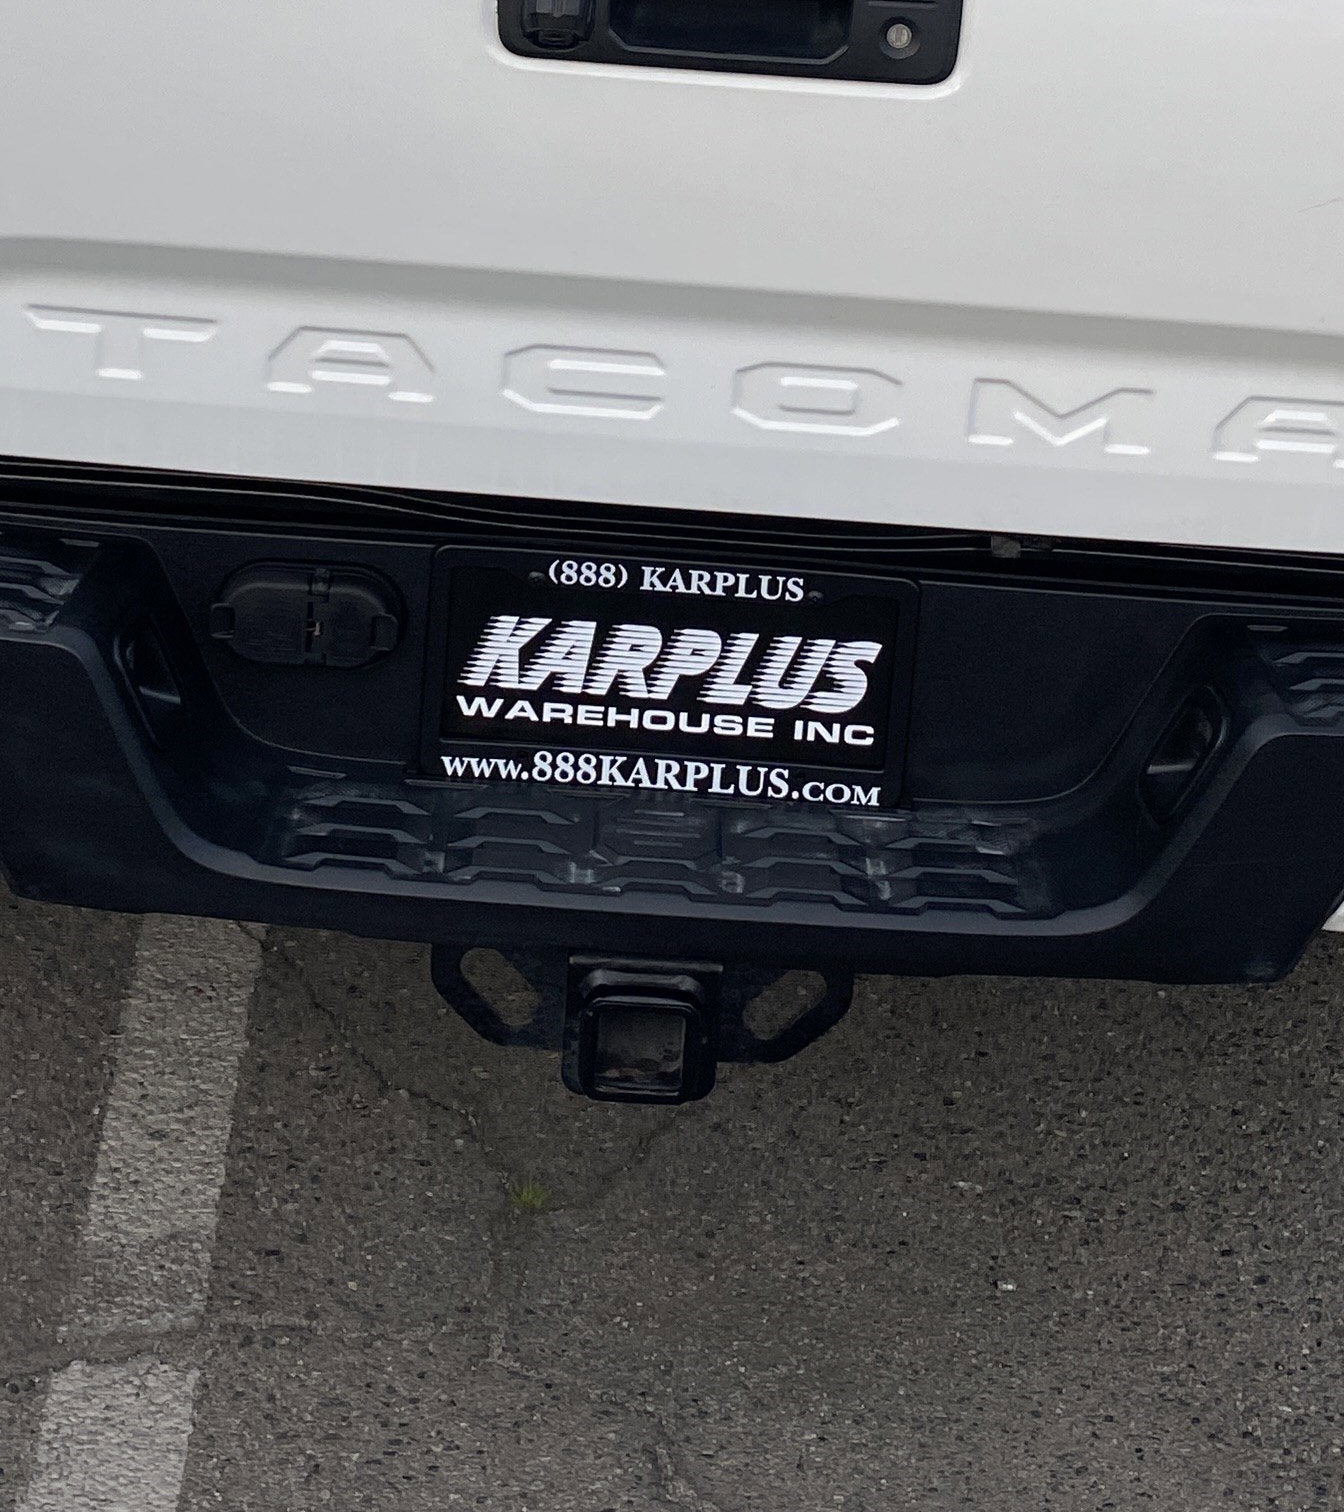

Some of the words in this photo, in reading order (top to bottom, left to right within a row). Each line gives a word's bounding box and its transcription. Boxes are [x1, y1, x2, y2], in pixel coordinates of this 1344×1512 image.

[548, 559, 628, 589] (888)
[640, 565, 805, 602] KARPLUS
[457, 614, 883, 714] KARPLUS
[456, 694, 775, 739] WAREHOUSE
[793, 719, 875, 746] INC
